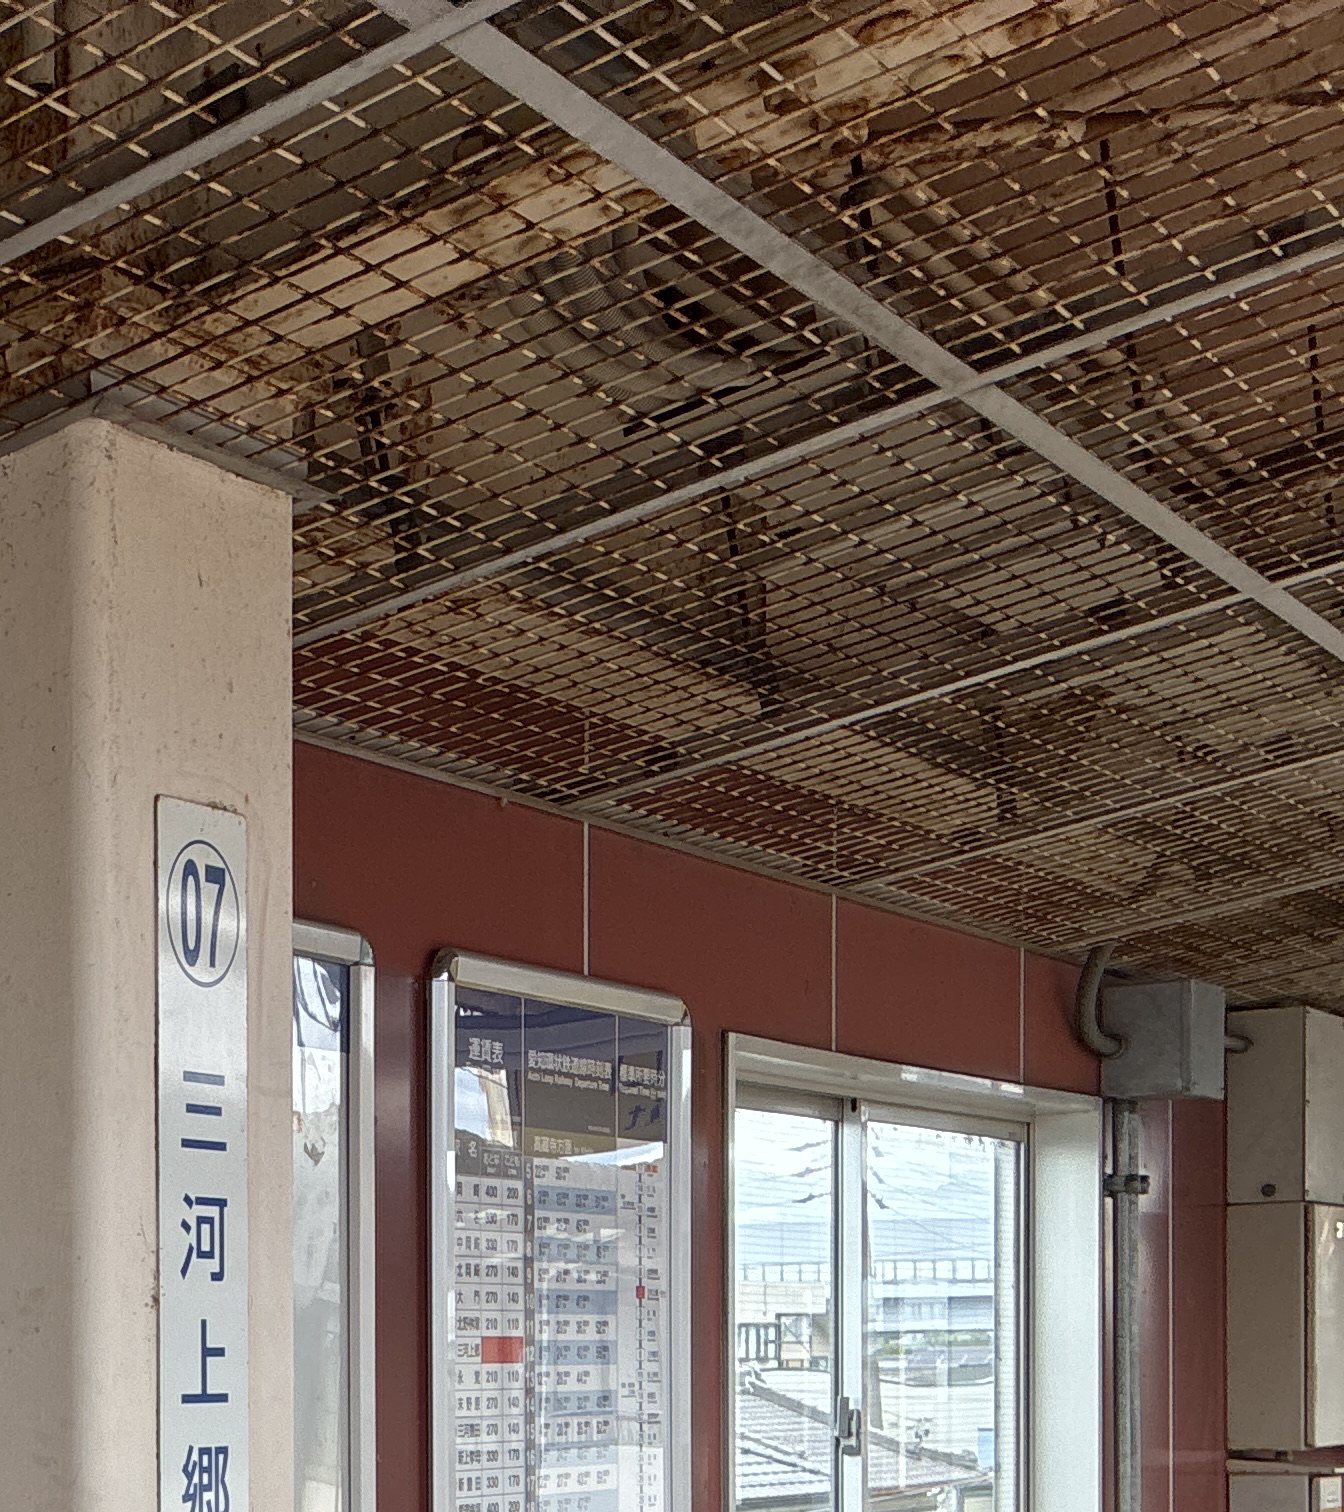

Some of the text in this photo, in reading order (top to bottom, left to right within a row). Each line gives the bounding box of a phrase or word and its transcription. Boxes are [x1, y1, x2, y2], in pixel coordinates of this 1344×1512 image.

[181, 859, 226, 968] 07
[526, 1216, 533, 1231] 7
[526, 1319, 534, 1335] 11
